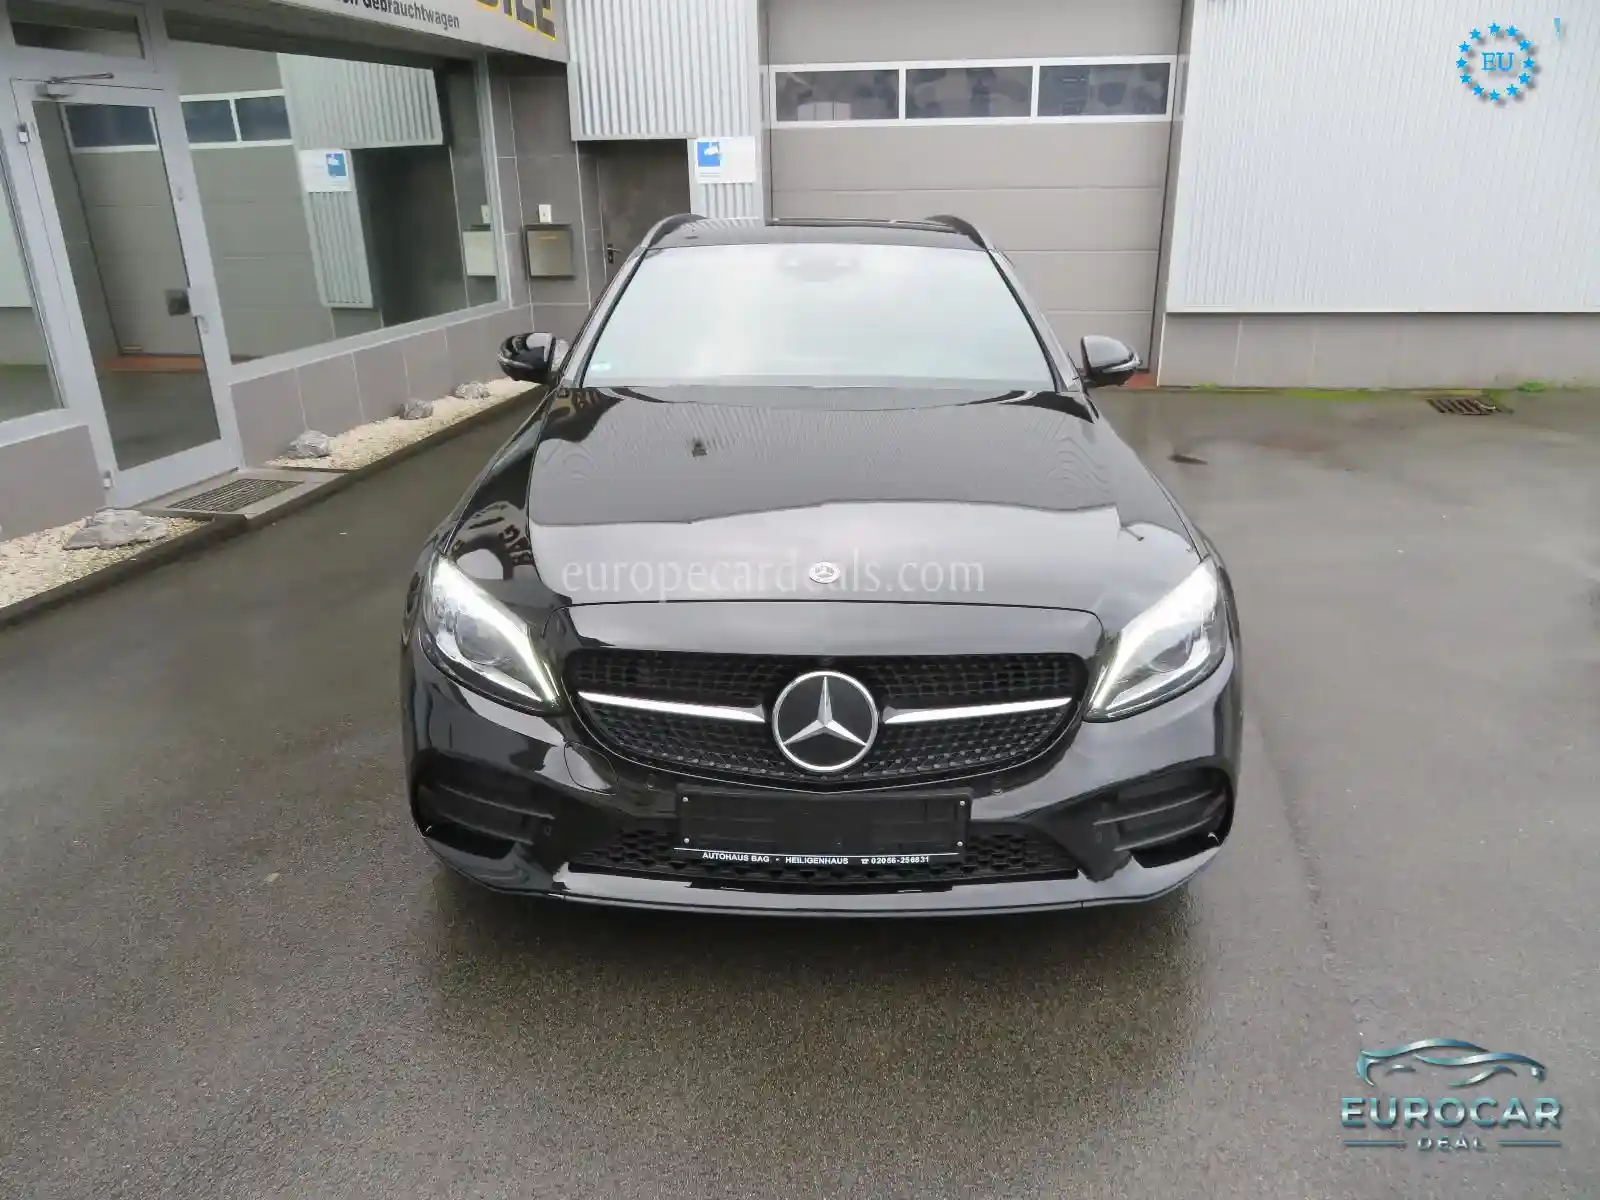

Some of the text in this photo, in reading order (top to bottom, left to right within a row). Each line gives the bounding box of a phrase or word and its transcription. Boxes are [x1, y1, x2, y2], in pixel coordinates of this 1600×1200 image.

[702, 851, 749, 862] AUTOHAUS
[751, 855, 770, 863] BAG
[785, 856, 849, 865] HEILIGENHAUS
